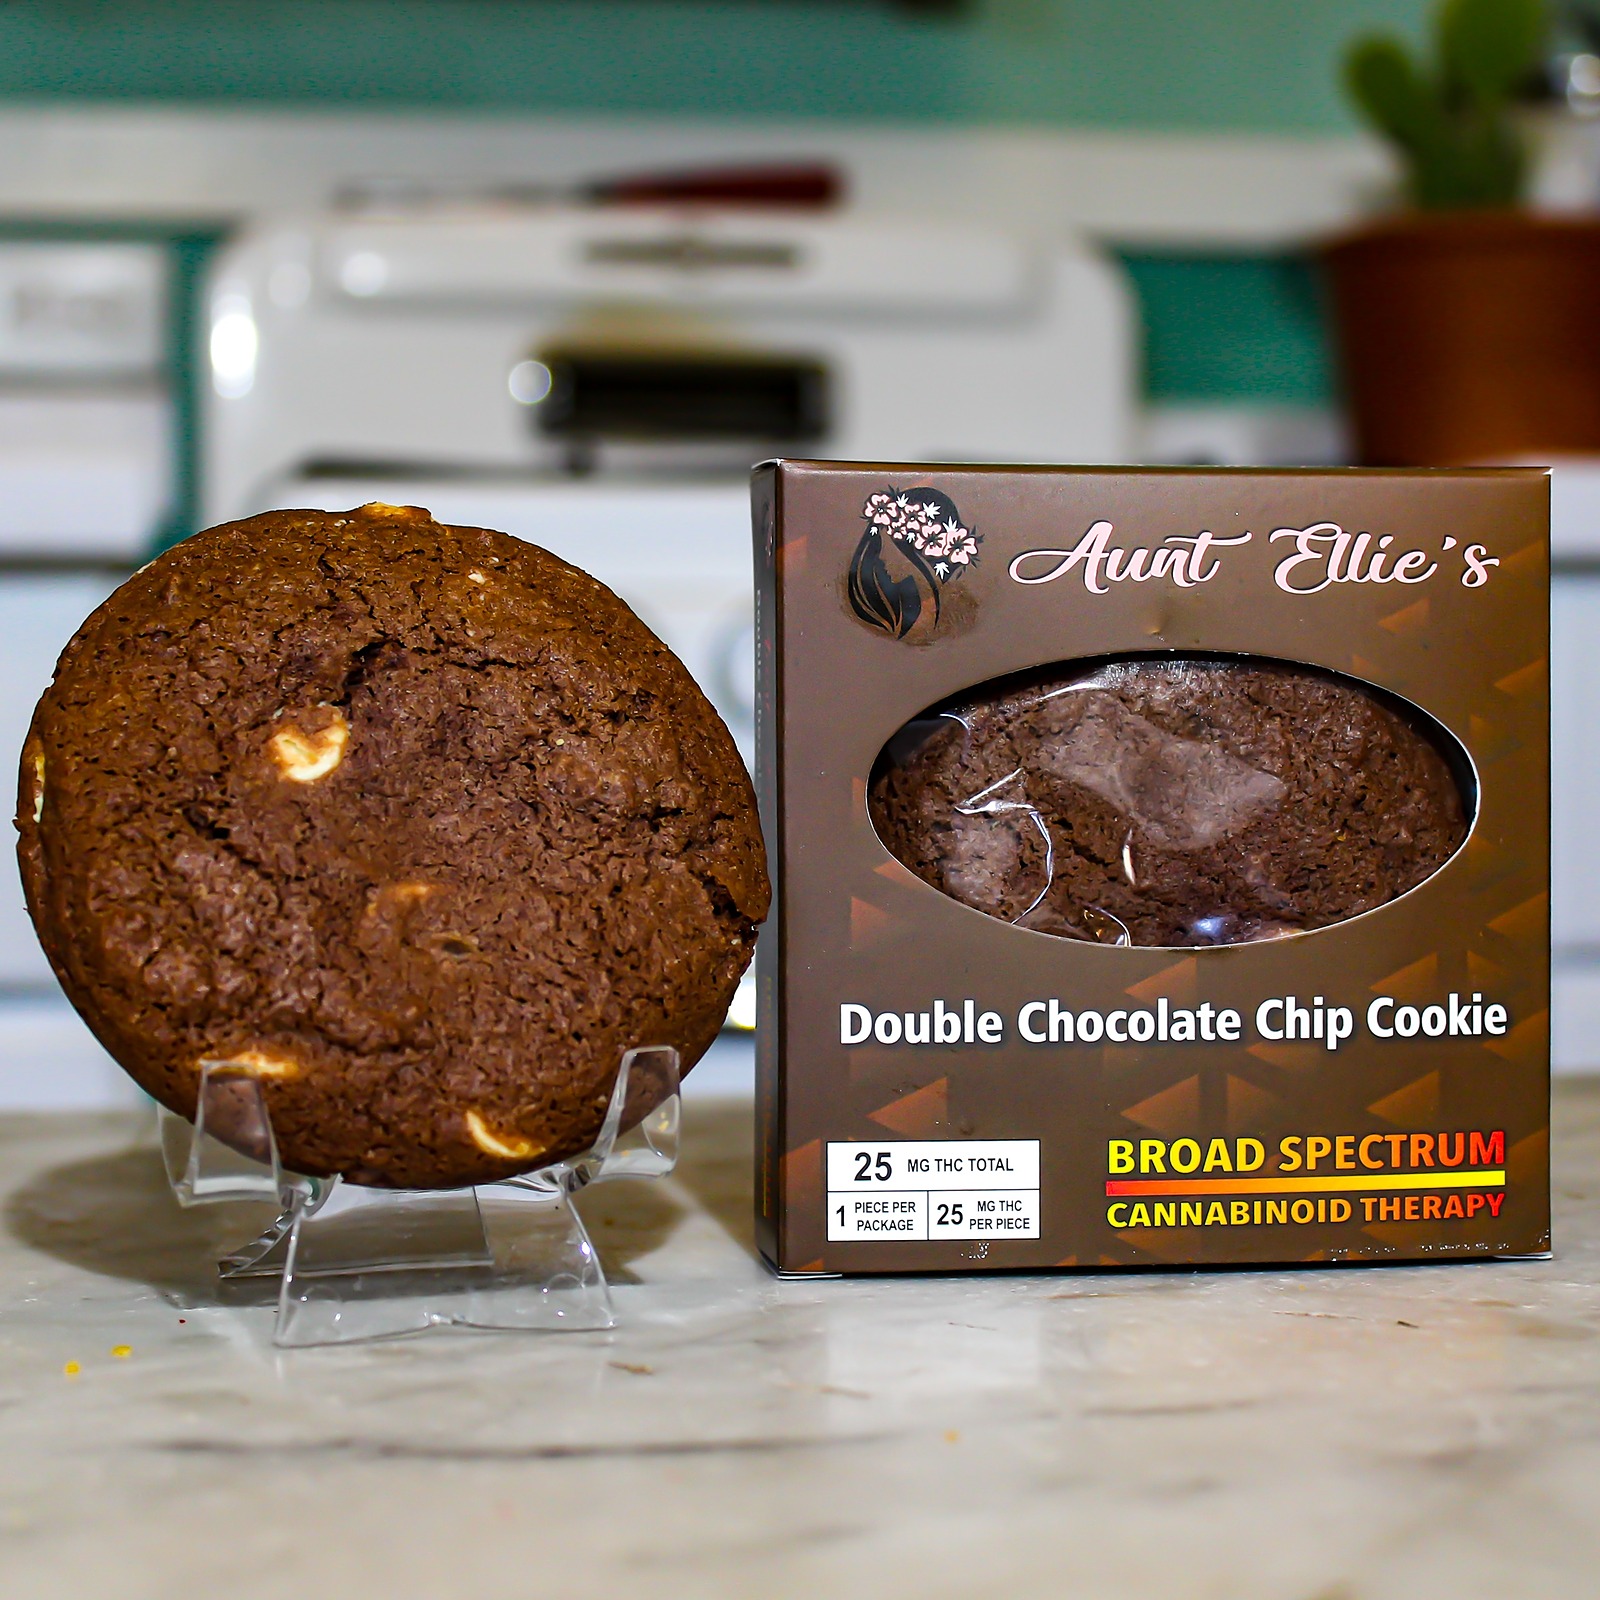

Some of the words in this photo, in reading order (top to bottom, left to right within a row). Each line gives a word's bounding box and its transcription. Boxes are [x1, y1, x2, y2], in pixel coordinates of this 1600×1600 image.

[1008, 520, 1253, 594] Aunt
[1270, 522, 1500, 594] Ellie's
[840, 1000, 1003, 1045] Double
[1017, 999, 1241, 1044] Chocolate
[1254, 995, 1354, 1050] Chip
[1366, 993, 1508, 1038] Cookie
[1107, 1138, 1265, 1174] BROAD
[1278, 1131, 1505, 1171] SPECTRUM
[854, 1152, 892, 1181] 25
[907, 1159, 930, 1172] MG
[934, 1158, 963, 1171] THC
[968, 1157, 1014, 1171] TOTAL
[836, 1205, 845, 1227] 1
[854, 1202, 889, 1213] PIECE
[892, 1201, 916, 1212] PER
[937, 1204, 963, 1225] 25
[977, 1201, 996, 1211] MG
[999, 1200, 1023, 1211] THC
[1106, 1200, 1352, 1228] CANNABINOID
[1359, 1193, 1505, 1222] THERAPY
[857, 1220, 914, 1231] PACKAGE
[969, 1218, 993, 1229] PER
[996, 1218, 1030, 1229] PIECE
